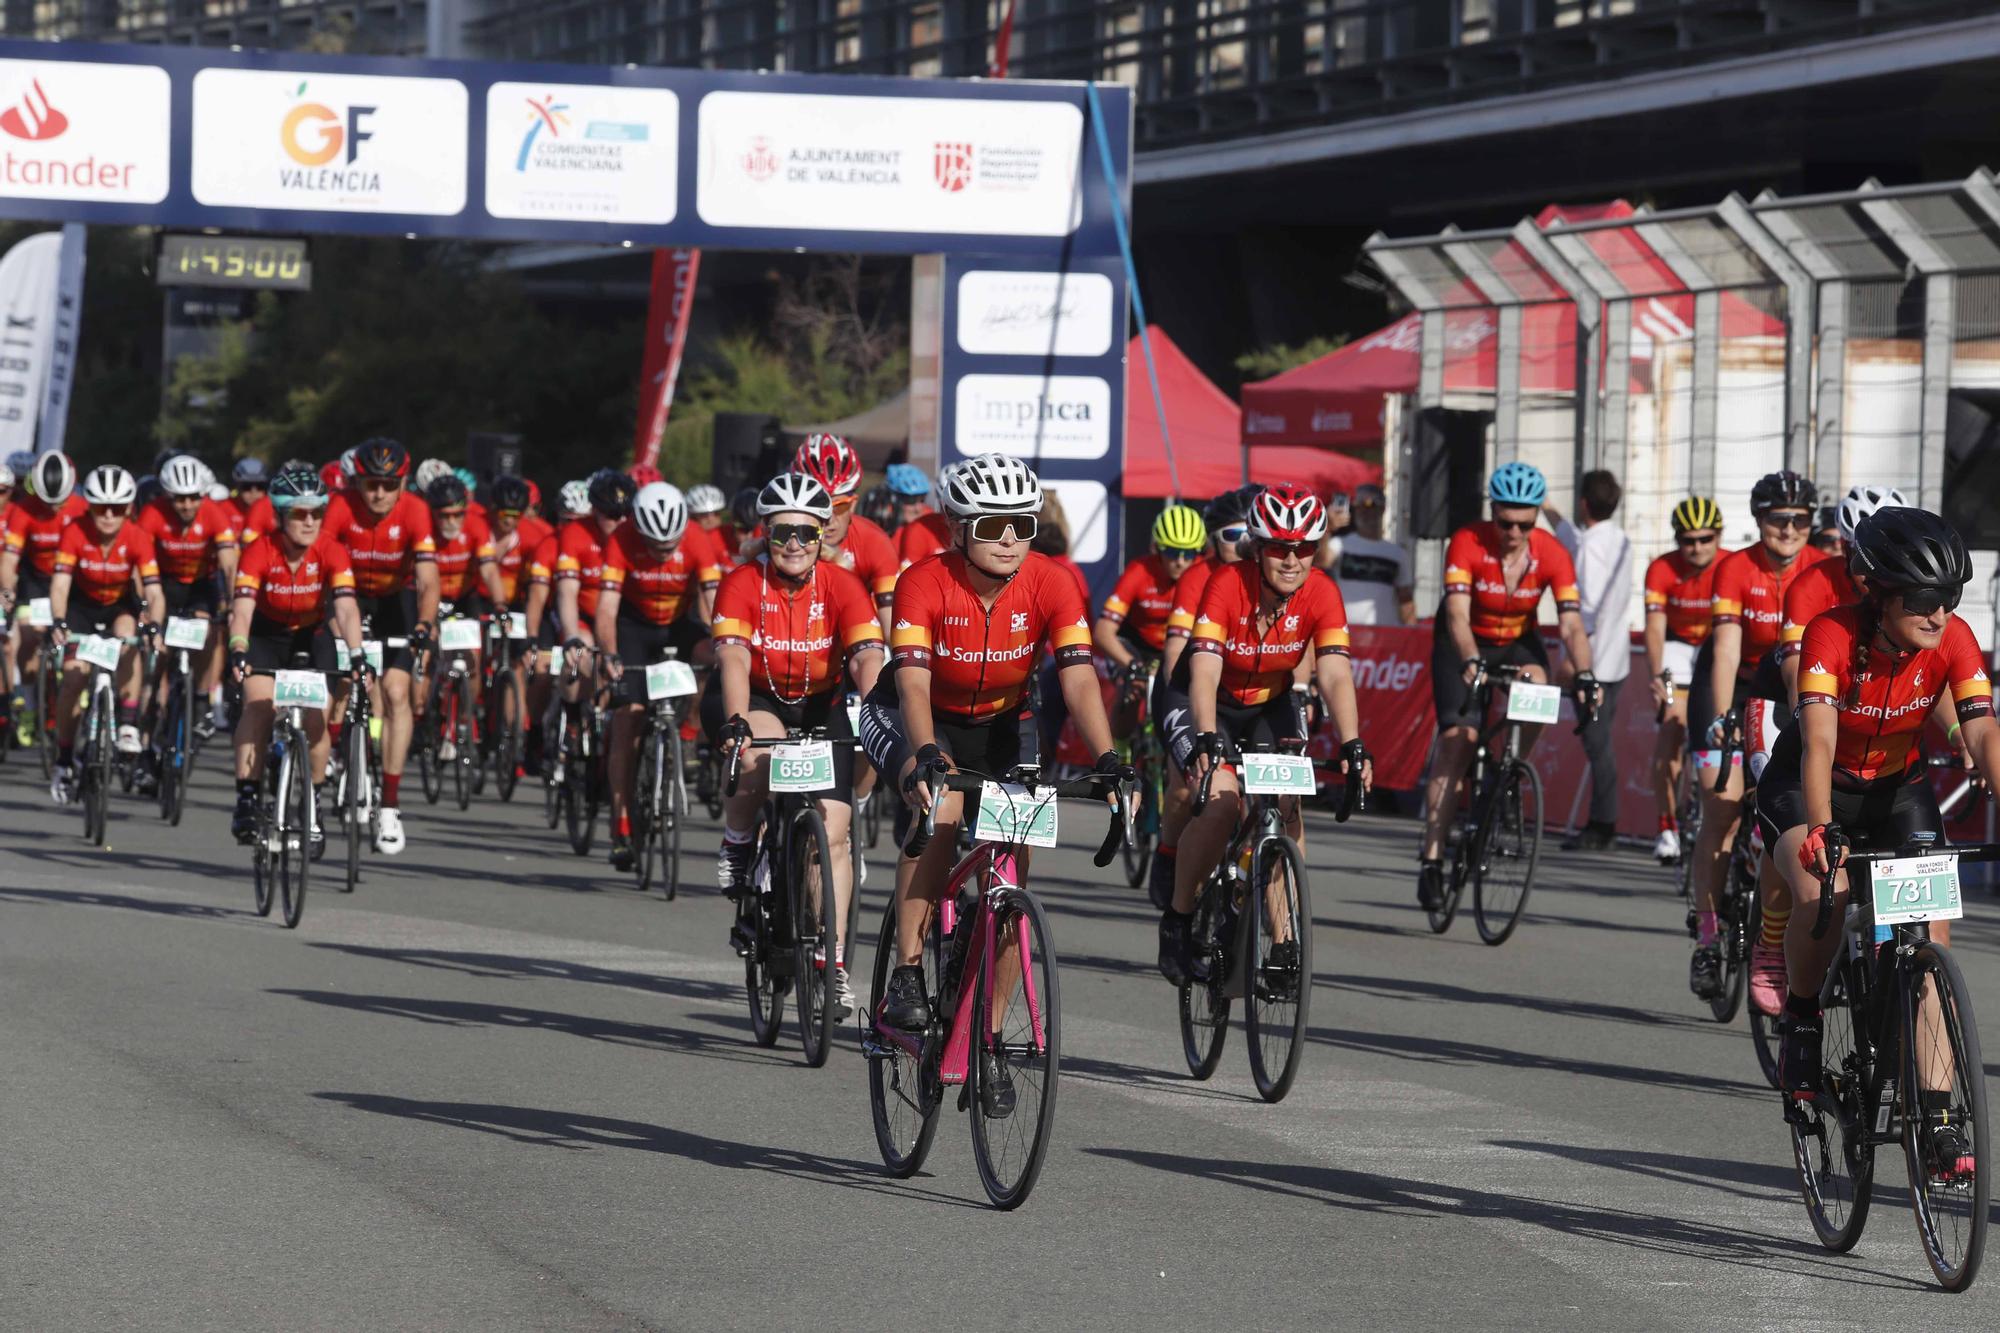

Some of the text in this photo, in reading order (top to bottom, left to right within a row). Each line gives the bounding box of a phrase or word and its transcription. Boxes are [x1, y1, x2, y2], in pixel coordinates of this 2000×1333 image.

[281, 104, 378, 166] GF
[789, 149, 901, 163] AJUNTAMENT
[0, 153, 137, 188] tander
[787, 167, 808, 182] DE
[764, 636, 833, 653] Santander
[952, 642, 1035, 662] Santander
[283, 683, 311, 697] 713
[780, 760, 814, 778] 659
[1255, 765, 1292, 781] 719
[1887, 878, 1933, 904] 731
